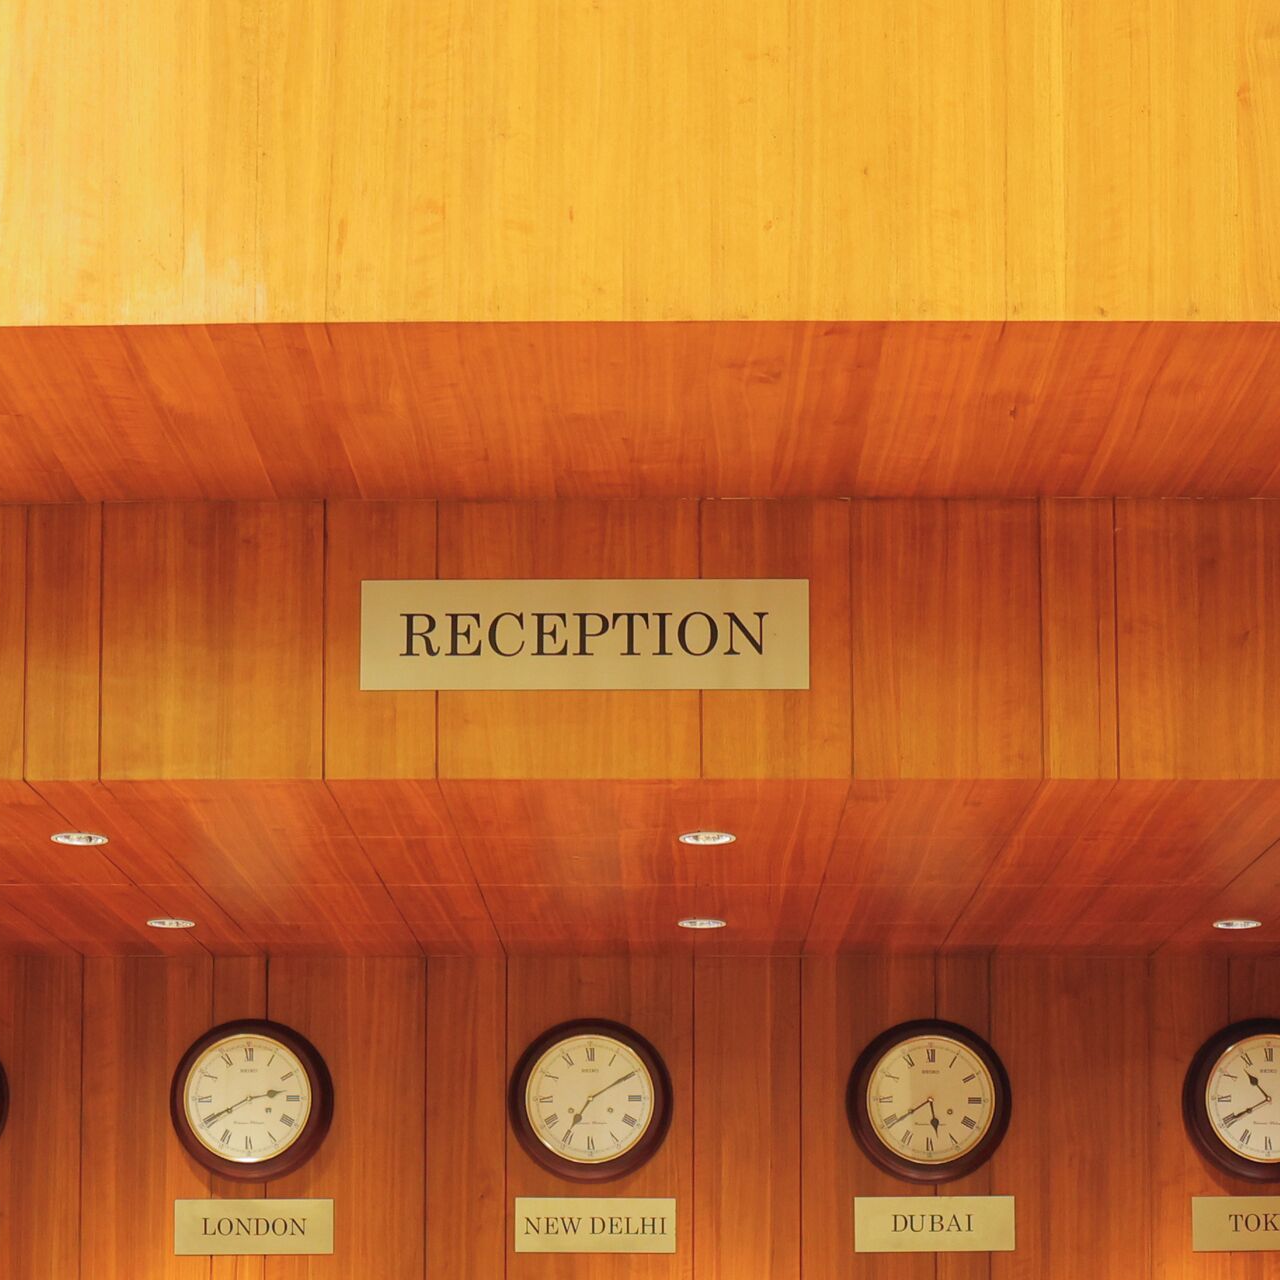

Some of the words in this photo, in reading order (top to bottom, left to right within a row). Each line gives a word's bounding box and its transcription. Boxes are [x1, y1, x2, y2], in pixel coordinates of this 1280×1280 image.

[399, 612, 770, 657] RECEPTION
[202, 1218, 307, 1235] LONDON
[524, 1217, 583, 1234] NEW
[590, 1217, 666, 1234] DELHI
[892, 1214, 972, 1232] DUBAI
